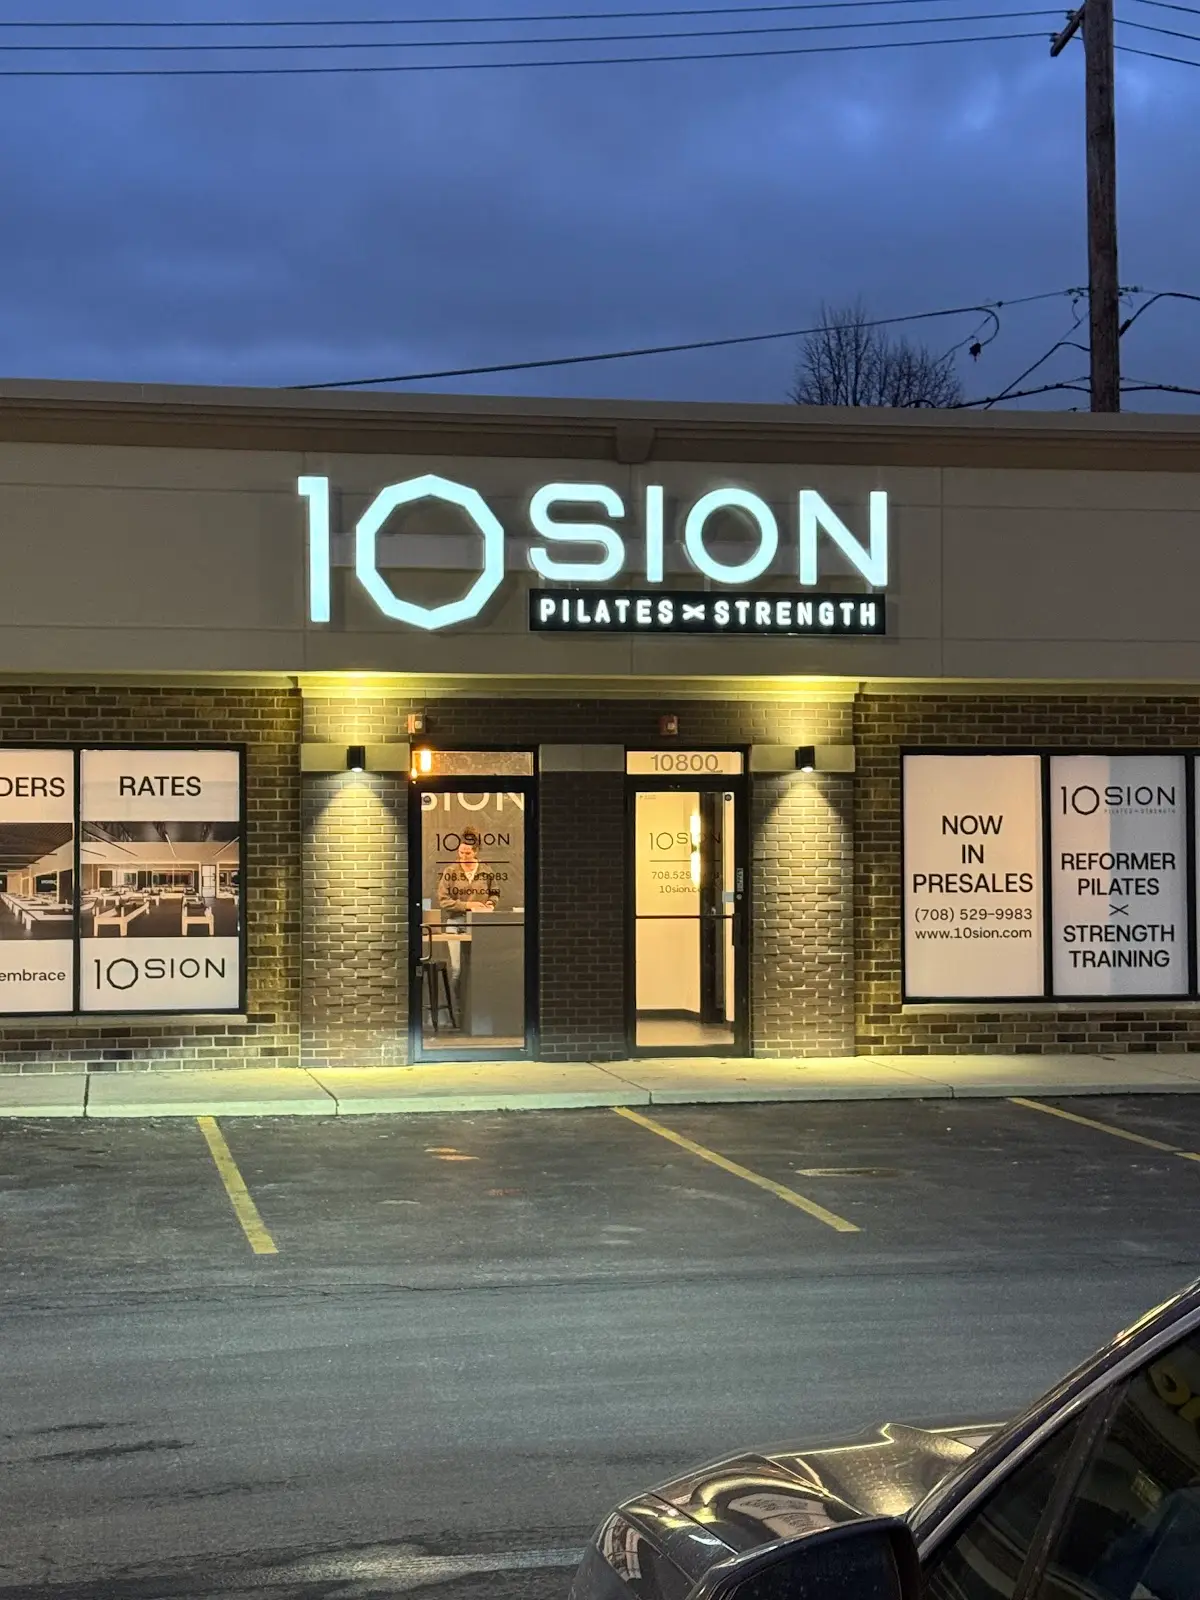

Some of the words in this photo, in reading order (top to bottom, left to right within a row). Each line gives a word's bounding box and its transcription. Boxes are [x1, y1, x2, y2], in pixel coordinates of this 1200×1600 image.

[298, 474, 888, 630] 10SION
[539, 599, 674, 625] PILATES
[713, 601, 877, 627] STRENGTH
[650, 754, 719, 771] 10800
[119, 776, 202, 796] RATES
[1061, 785, 1176, 815] 10SION
[942, 815, 1003, 835] NOW
[436, 833, 510, 851] 10SION
[961, 844, 984, 864] IN
[1061, 853, 1176, 870] REFORMER
[913, 873, 1033, 893] PRESALES
[1078, 878, 1160, 896] PILATES
[915, 907, 955, 922] (708)
[959, 908, 1033, 921] 529-9983
[915, 927, 1032, 939] www.10sion.com
[1063, 925, 1175, 943] STRENGTH
[1069, 950, 1170, 968] TRAINING
[0, 968, 66, 982] embrace
[94, 958, 225, 990] 10SION
